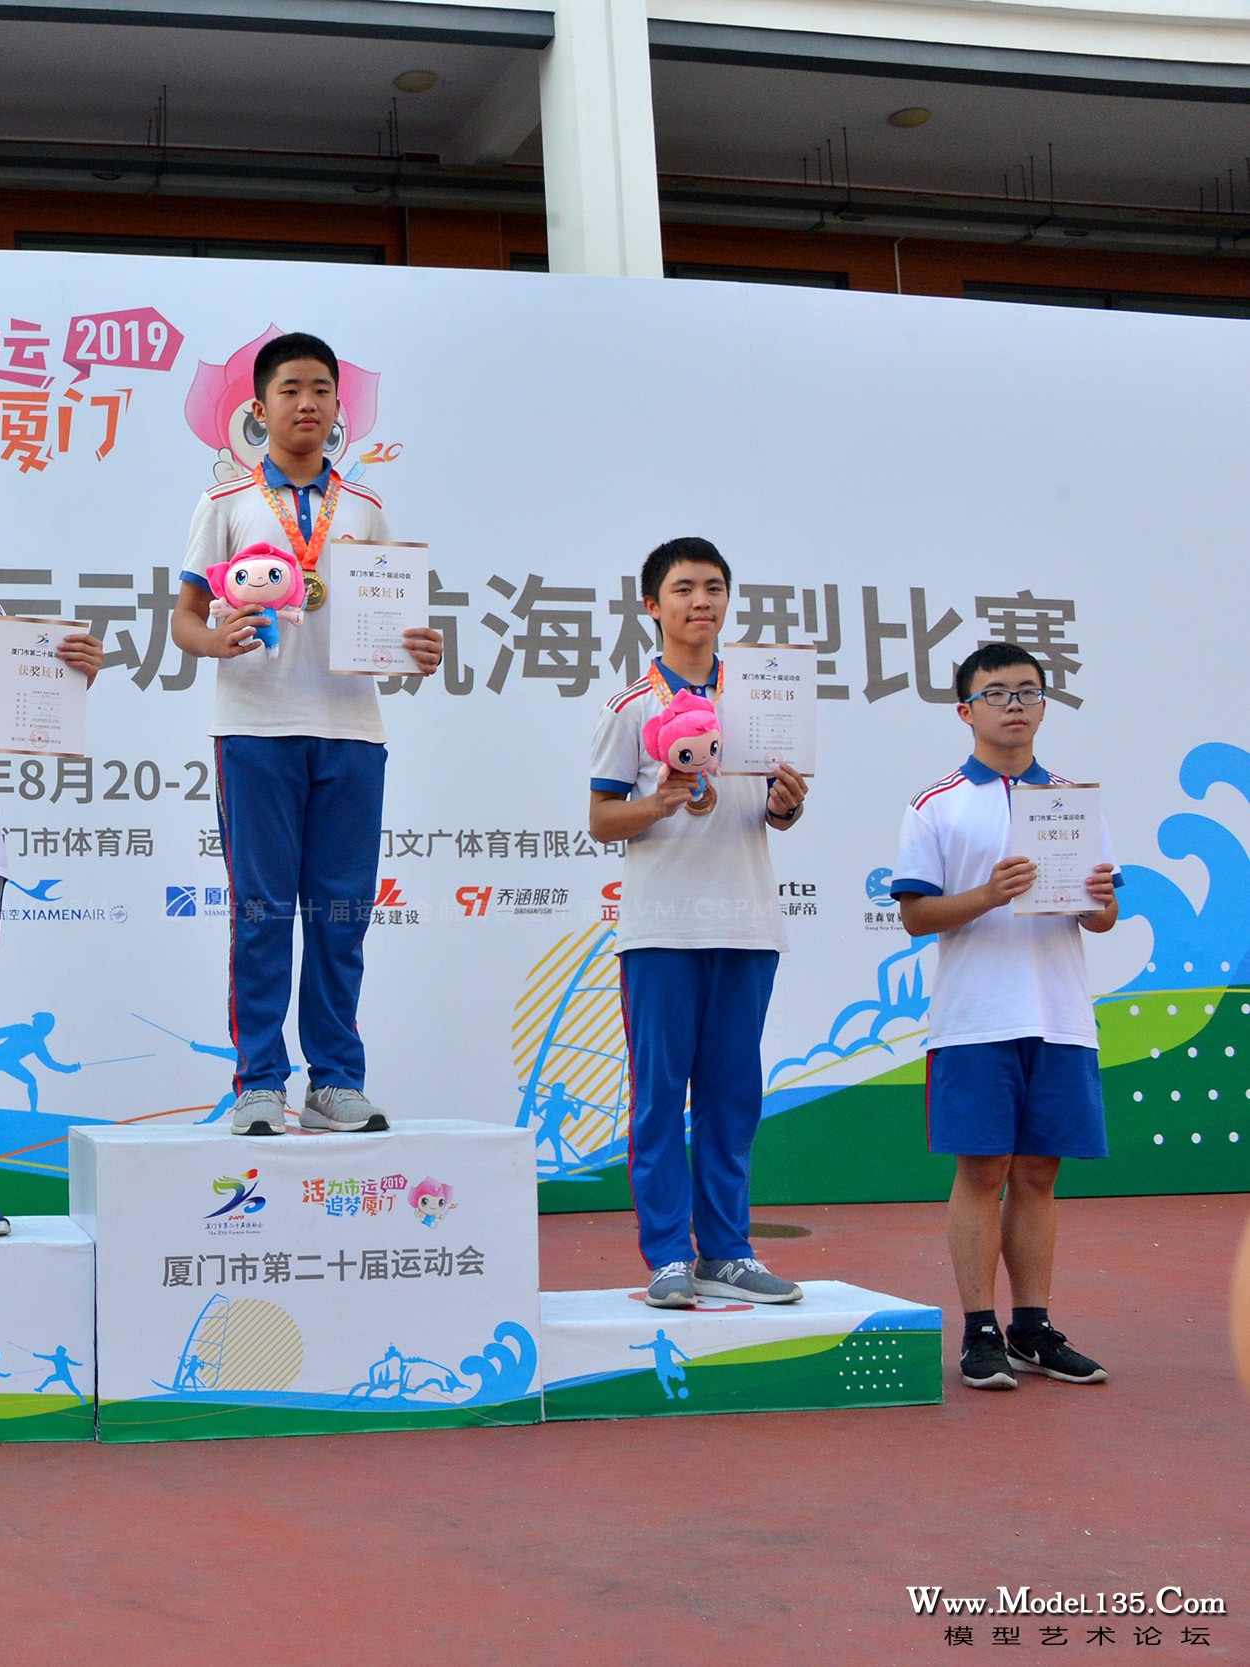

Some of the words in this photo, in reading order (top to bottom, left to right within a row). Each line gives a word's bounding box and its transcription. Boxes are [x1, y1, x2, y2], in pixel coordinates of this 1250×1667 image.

[75, 318, 169, 364] 2019
[358, 586, 405, 599] 获奖证书
[18, 665, 64, 678] 获奖证书
[750, 688, 794, 701] 获奖证书
[1037, 829, 1080, 841] 获奖证书
[497, 888, 569, 906] 乔涵服饰
[382, 1176, 405, 1189] 2019
[302, 1178, 378, 1204] 活力市运
[325, 1194, 396, 1217] 追梦厦门
[162, 1245, 485, 1287] 厦门市第二十届运动会
